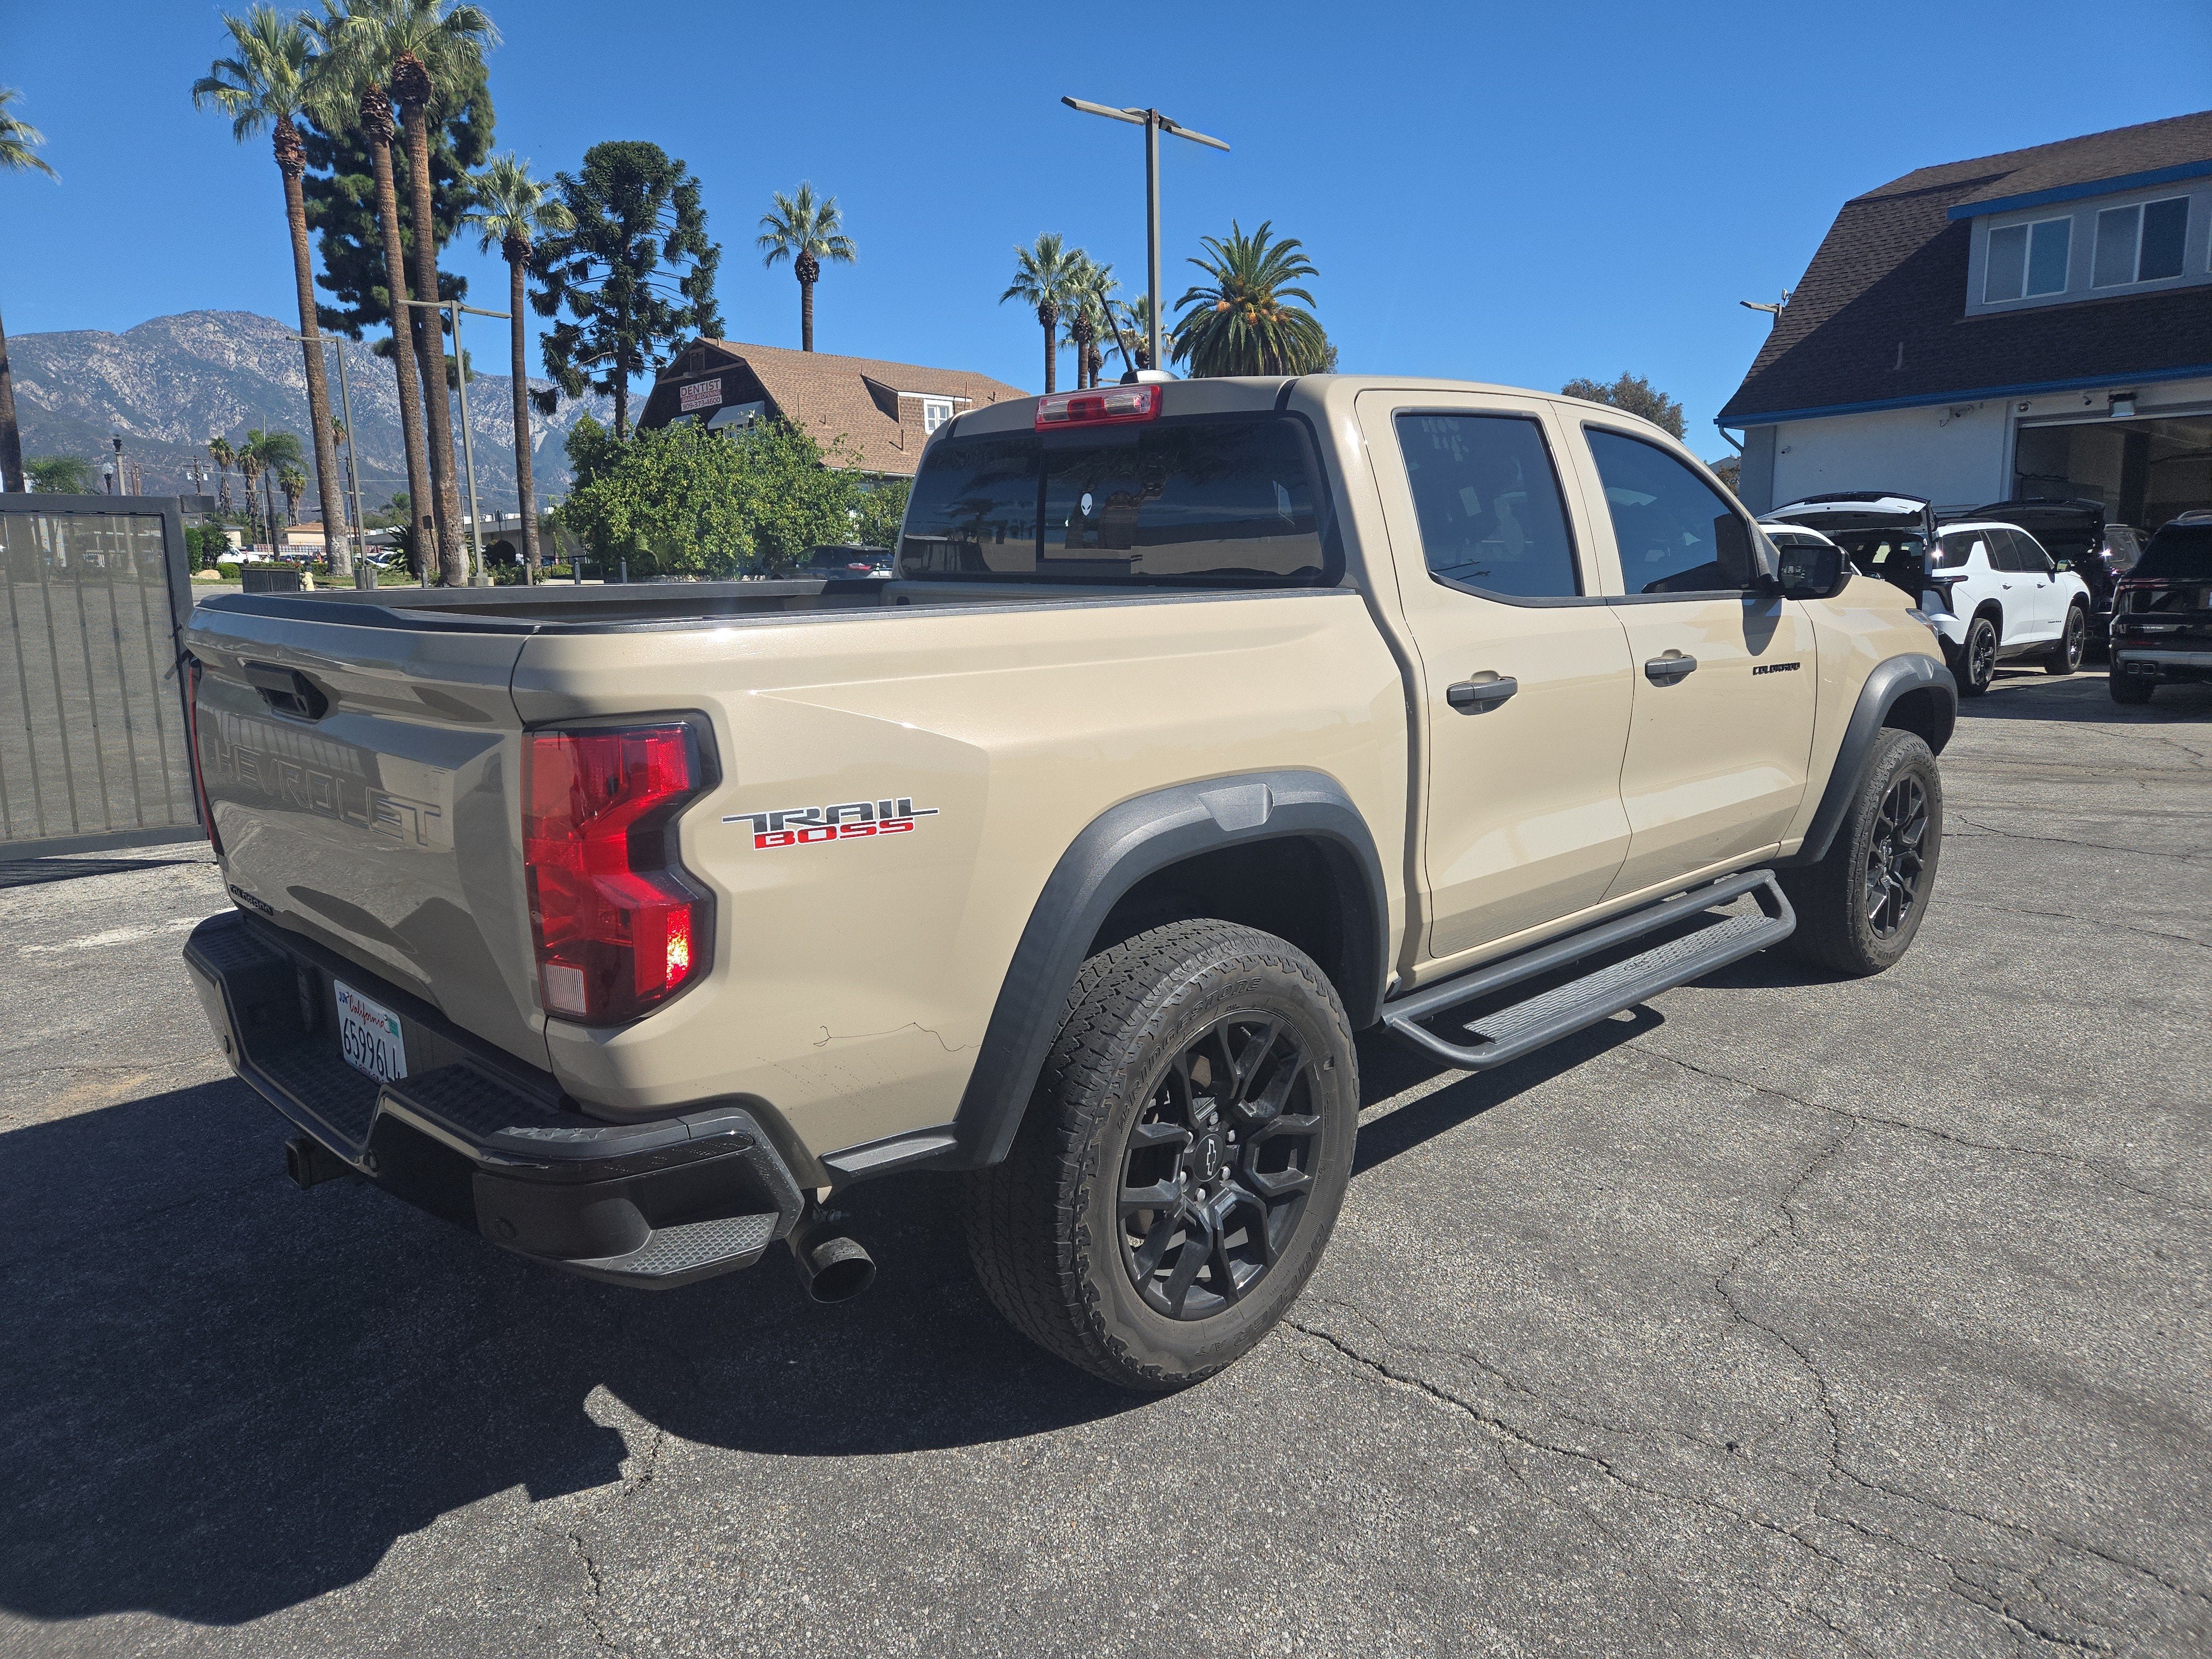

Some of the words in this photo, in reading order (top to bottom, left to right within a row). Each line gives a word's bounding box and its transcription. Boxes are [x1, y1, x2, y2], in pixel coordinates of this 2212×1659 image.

[681, 380, 720, 397] DENTIST
[683, 397, 721, 410] 909-373-4600
[200, 732, 442, 848] CHEVROLET
[722, 796, 940, 834] TRAIL
[753, 816, 916, 851] BOSS
[349, 994, 389, 1033] California
[1117, 975, 1263, 1134] BRIDGESTONE
